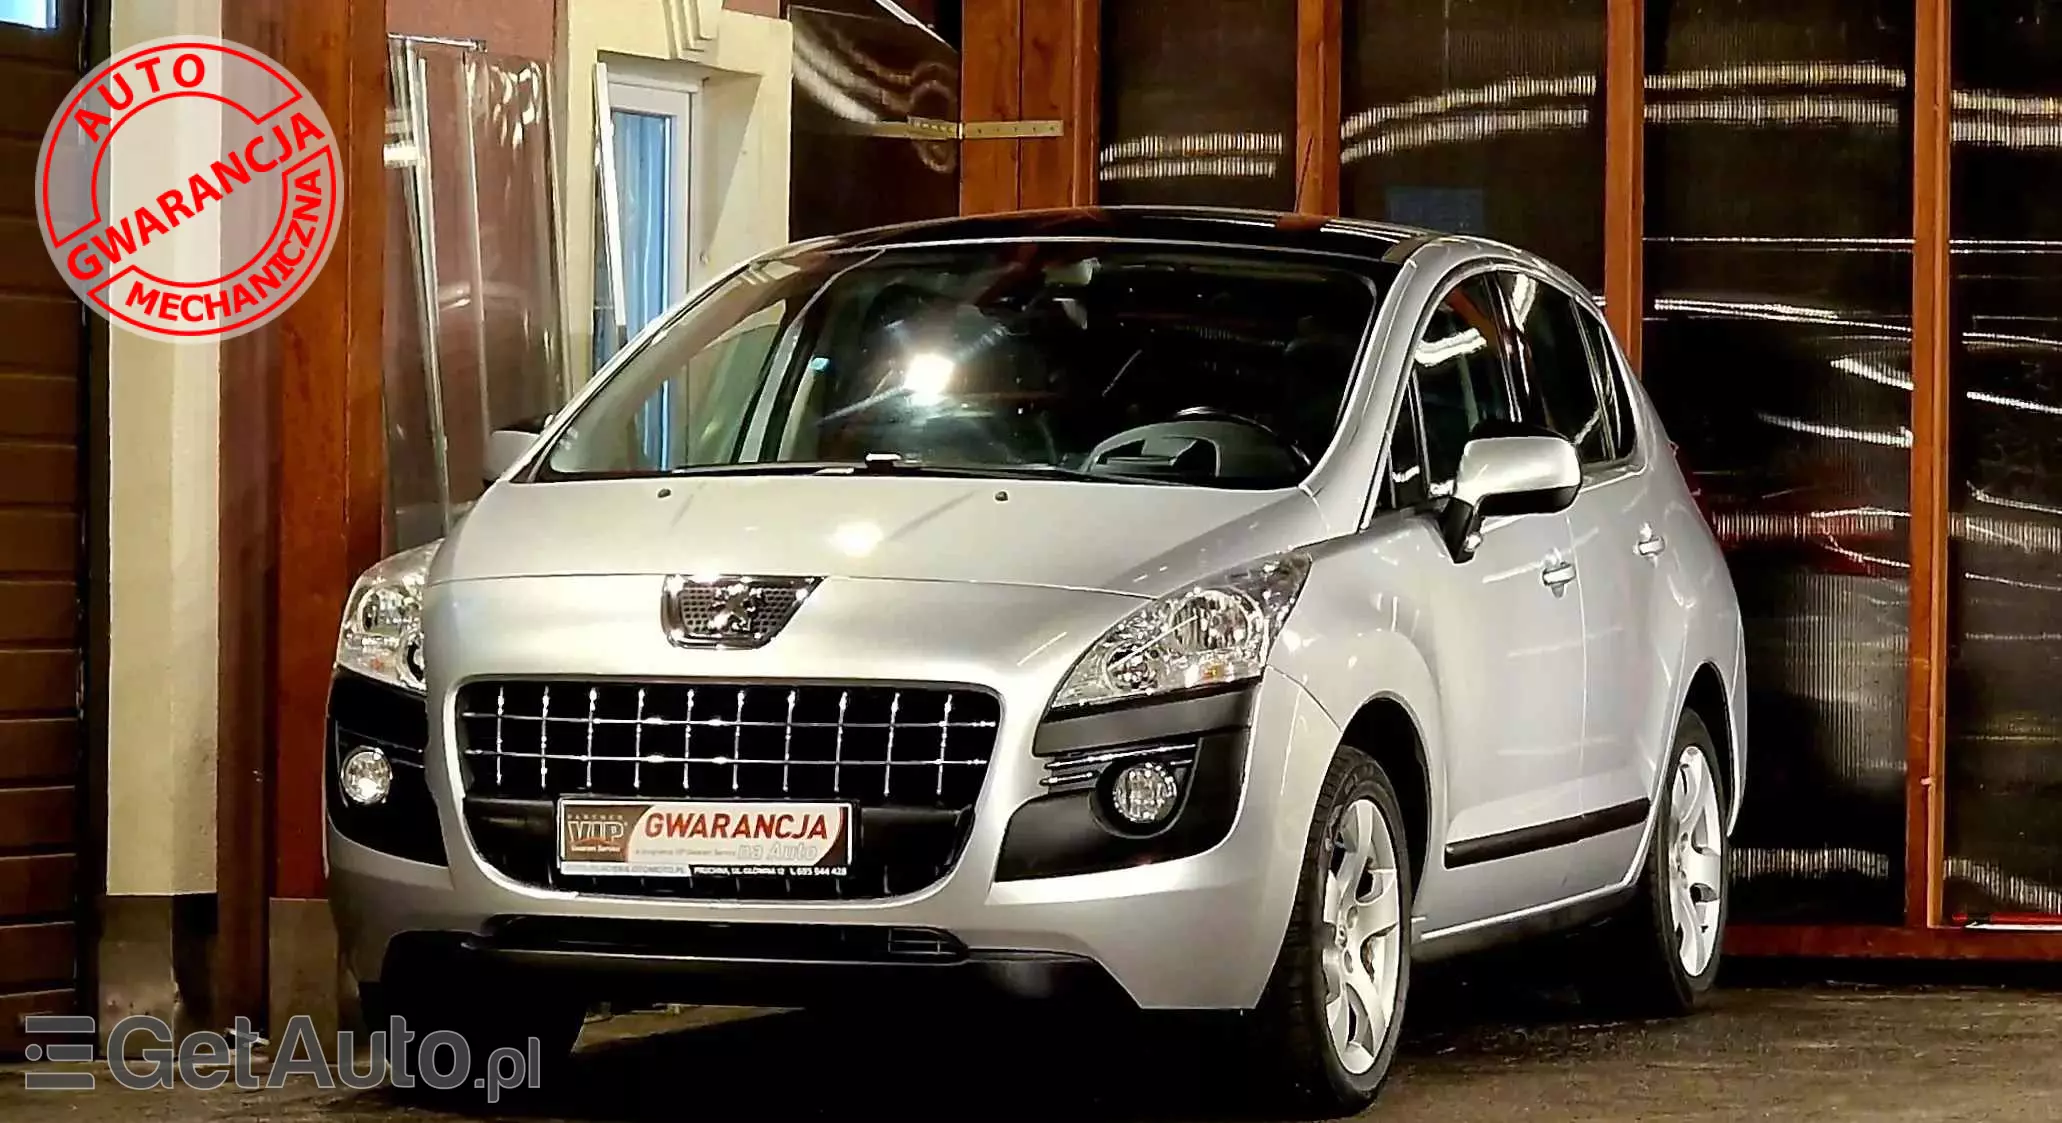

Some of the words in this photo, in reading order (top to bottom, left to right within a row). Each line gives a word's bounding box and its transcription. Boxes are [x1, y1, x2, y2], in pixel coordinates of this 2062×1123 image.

[567, 821, 625, 843] VIP
[644, 812, 829, 840] GWARANCJA
[737, 844, 764, 860] na
[766, 841, 819, 861] Auto
